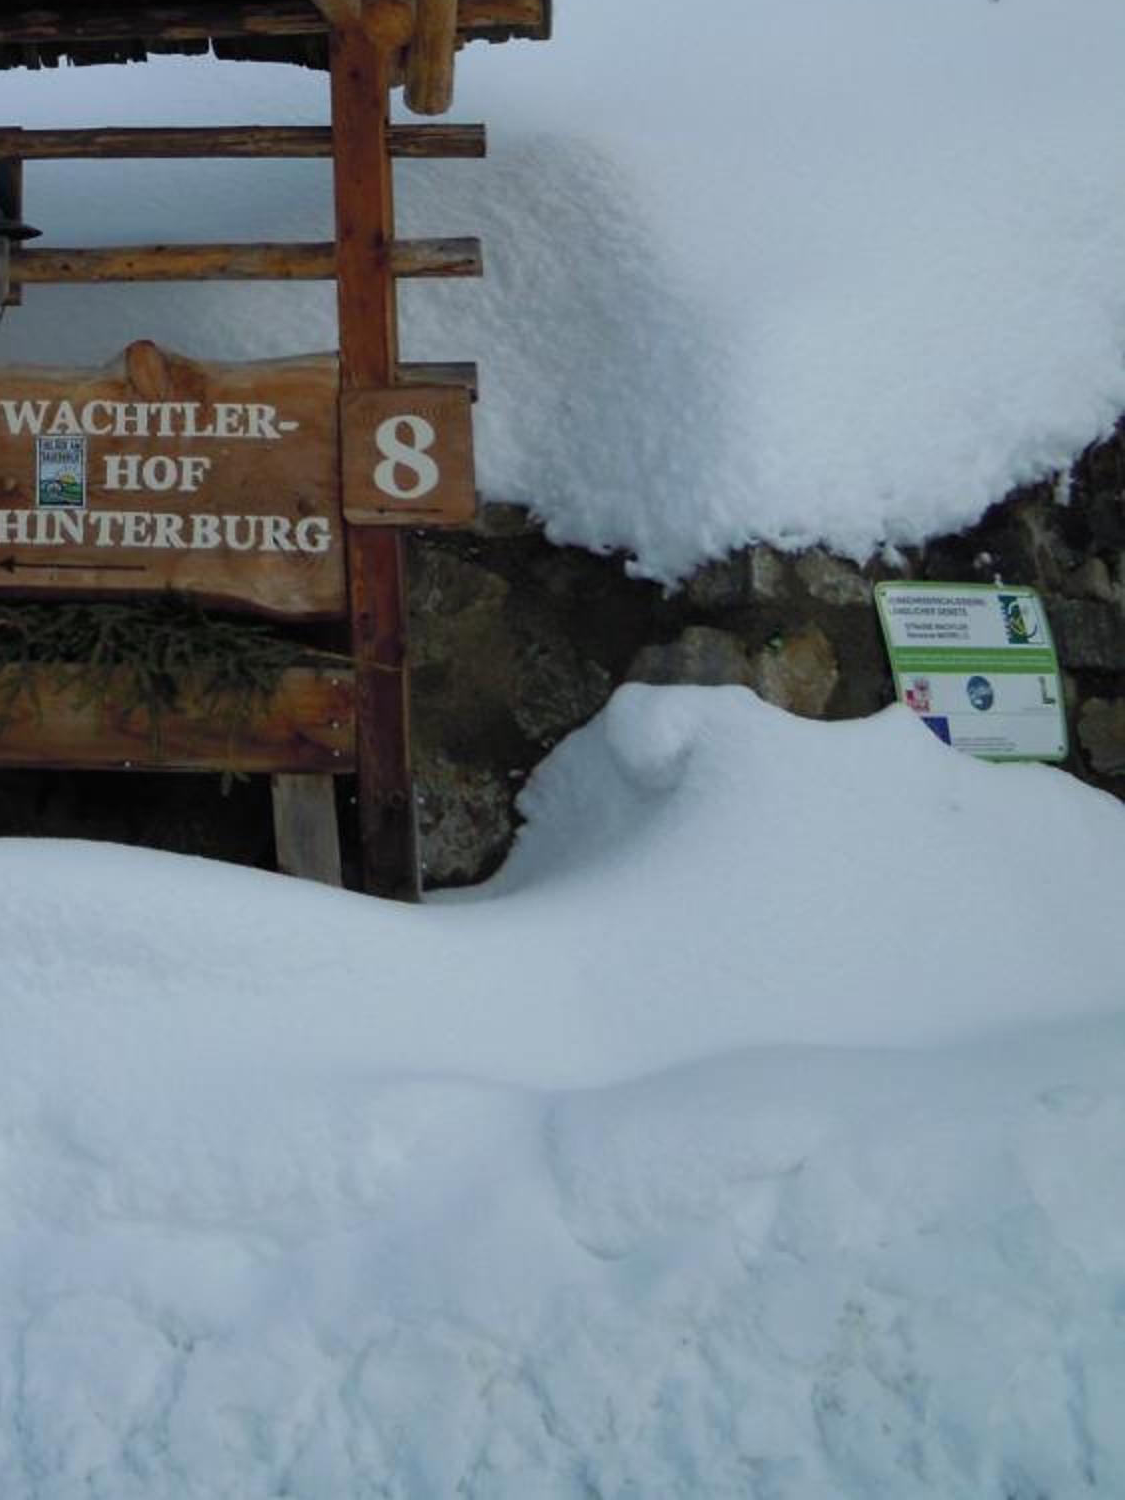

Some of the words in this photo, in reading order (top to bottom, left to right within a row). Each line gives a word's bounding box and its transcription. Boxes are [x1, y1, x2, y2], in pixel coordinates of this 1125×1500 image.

[0, 399, 300, 439] WACHTLER-
[103, 455, 211, 492] HOF
[373, 414, 440, 500] 8
